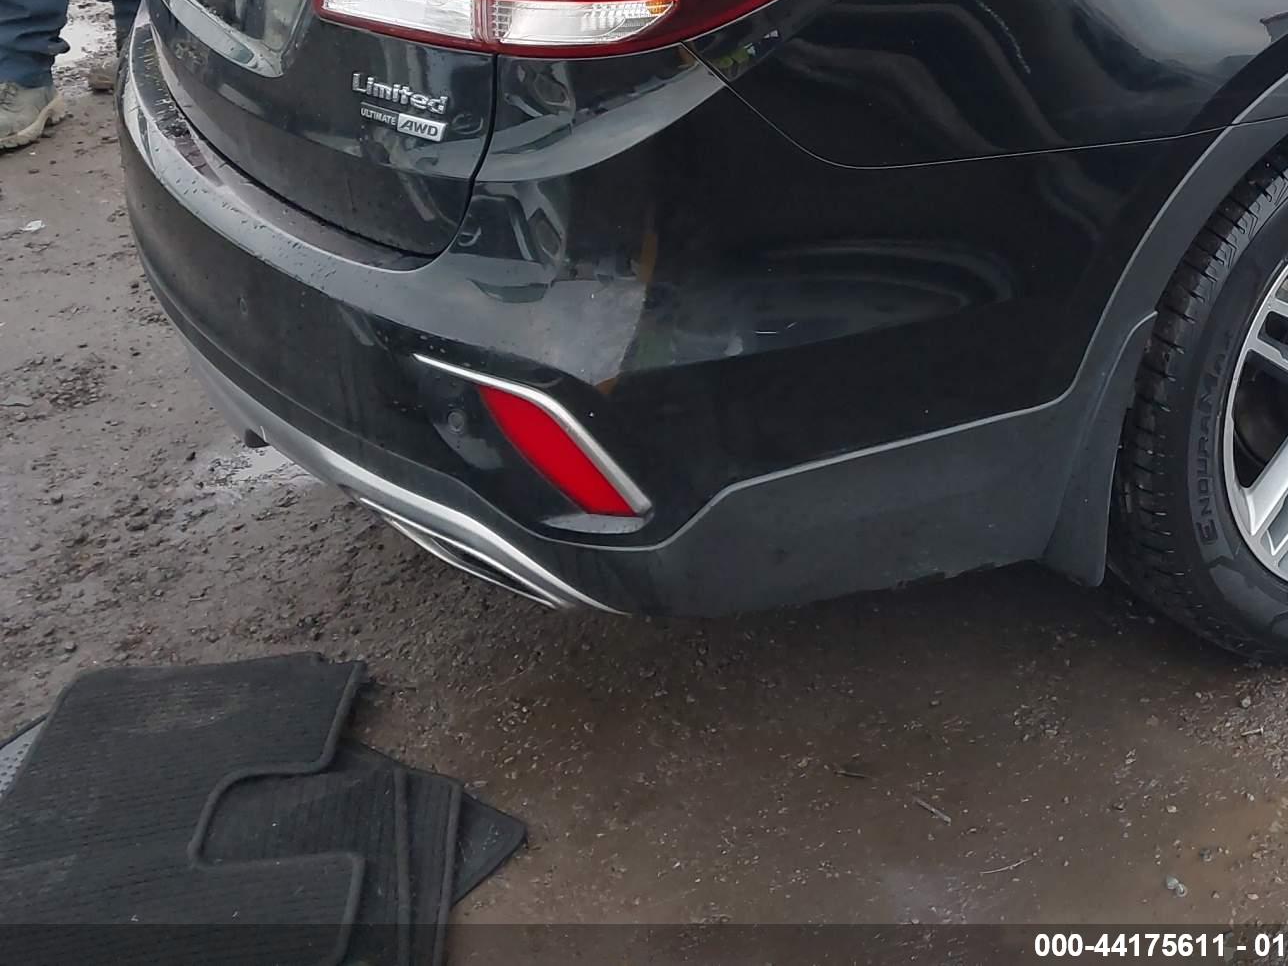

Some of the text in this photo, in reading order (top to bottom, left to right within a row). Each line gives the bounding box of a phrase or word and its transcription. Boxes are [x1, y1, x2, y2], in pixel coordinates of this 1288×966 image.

[352, 73, 449, 115] Limited
[360, 107, 439, 137] ULTIMATE AWD
